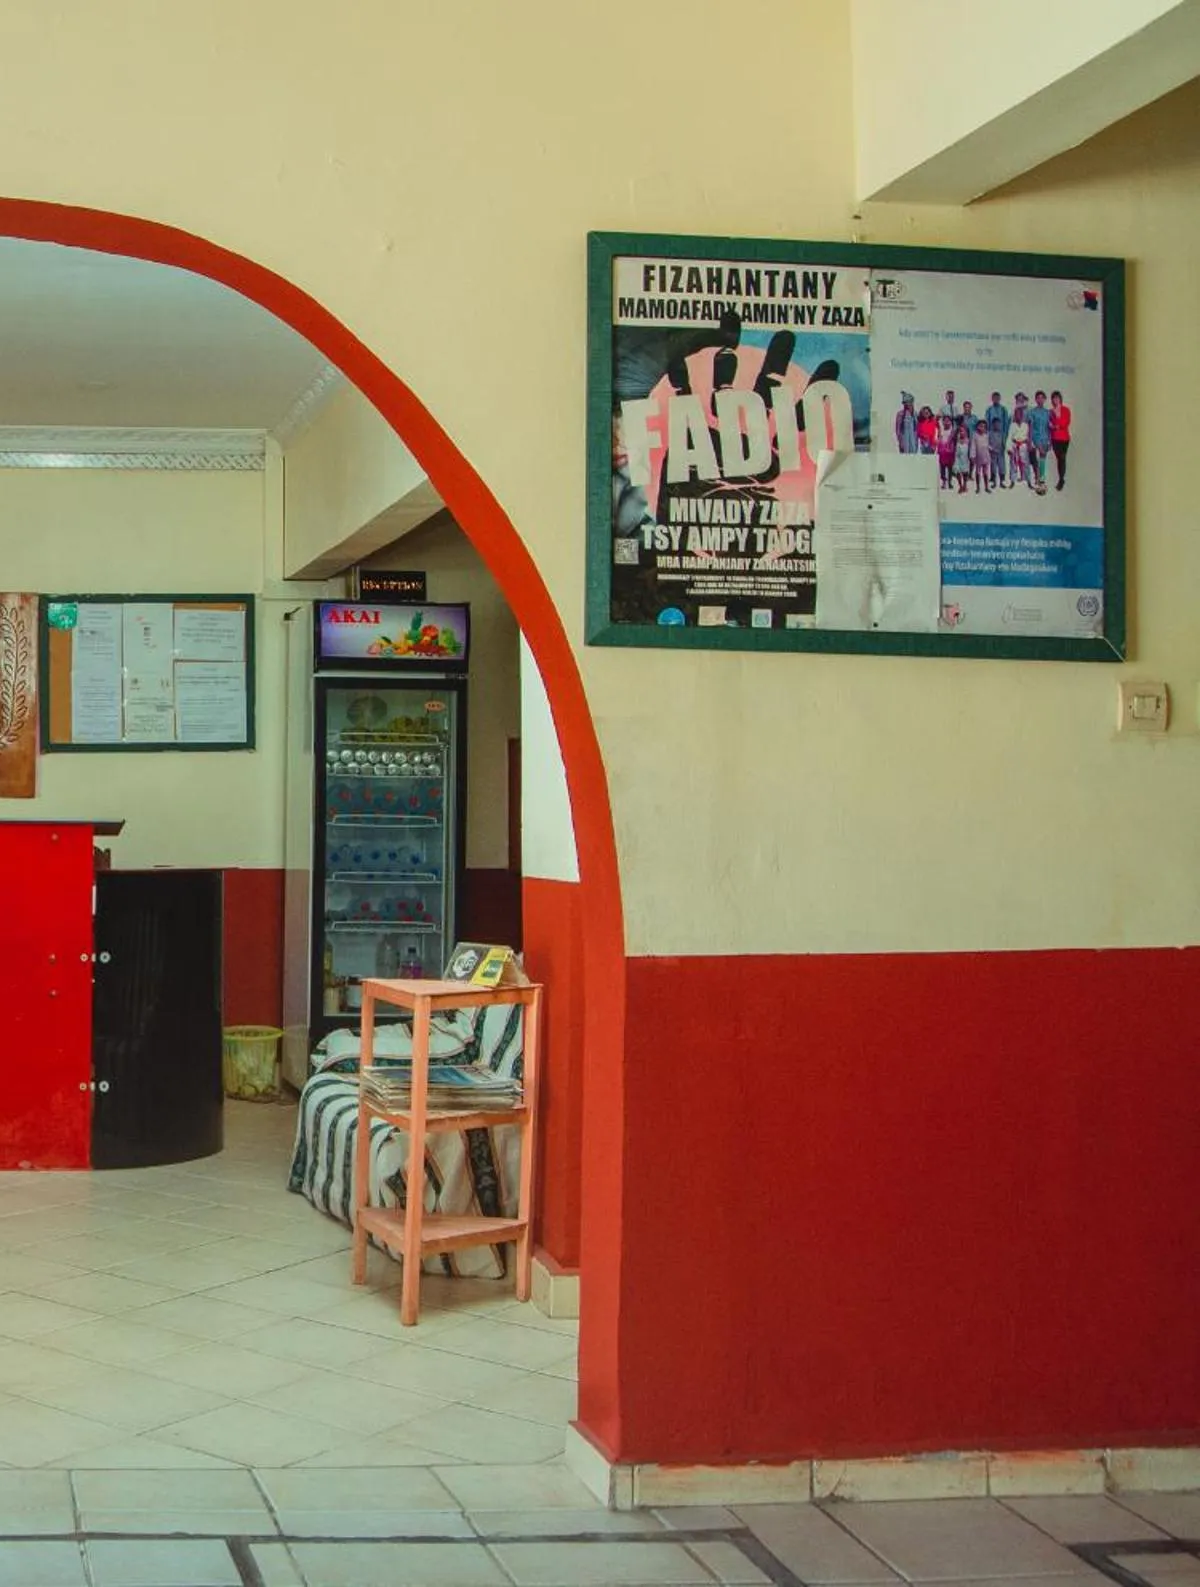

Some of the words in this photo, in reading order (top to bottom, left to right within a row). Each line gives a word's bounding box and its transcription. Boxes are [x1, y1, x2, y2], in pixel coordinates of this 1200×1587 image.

[643, 264, 837, 300] FIZAHANTANY
[618, 297, 738, 321] MAMOAFADY
[741, 303, 818, 325] AMIN'NY
[822, 306, 865, 327] ZAZA
[669, 497, 755, 525] MIVADY
[640, 524, 683, 551] TSY
[686, 525, 750, 553] AMPY
[753, 527, 817, 555] TAOG
[328, 608, 382, 624] AKAI
